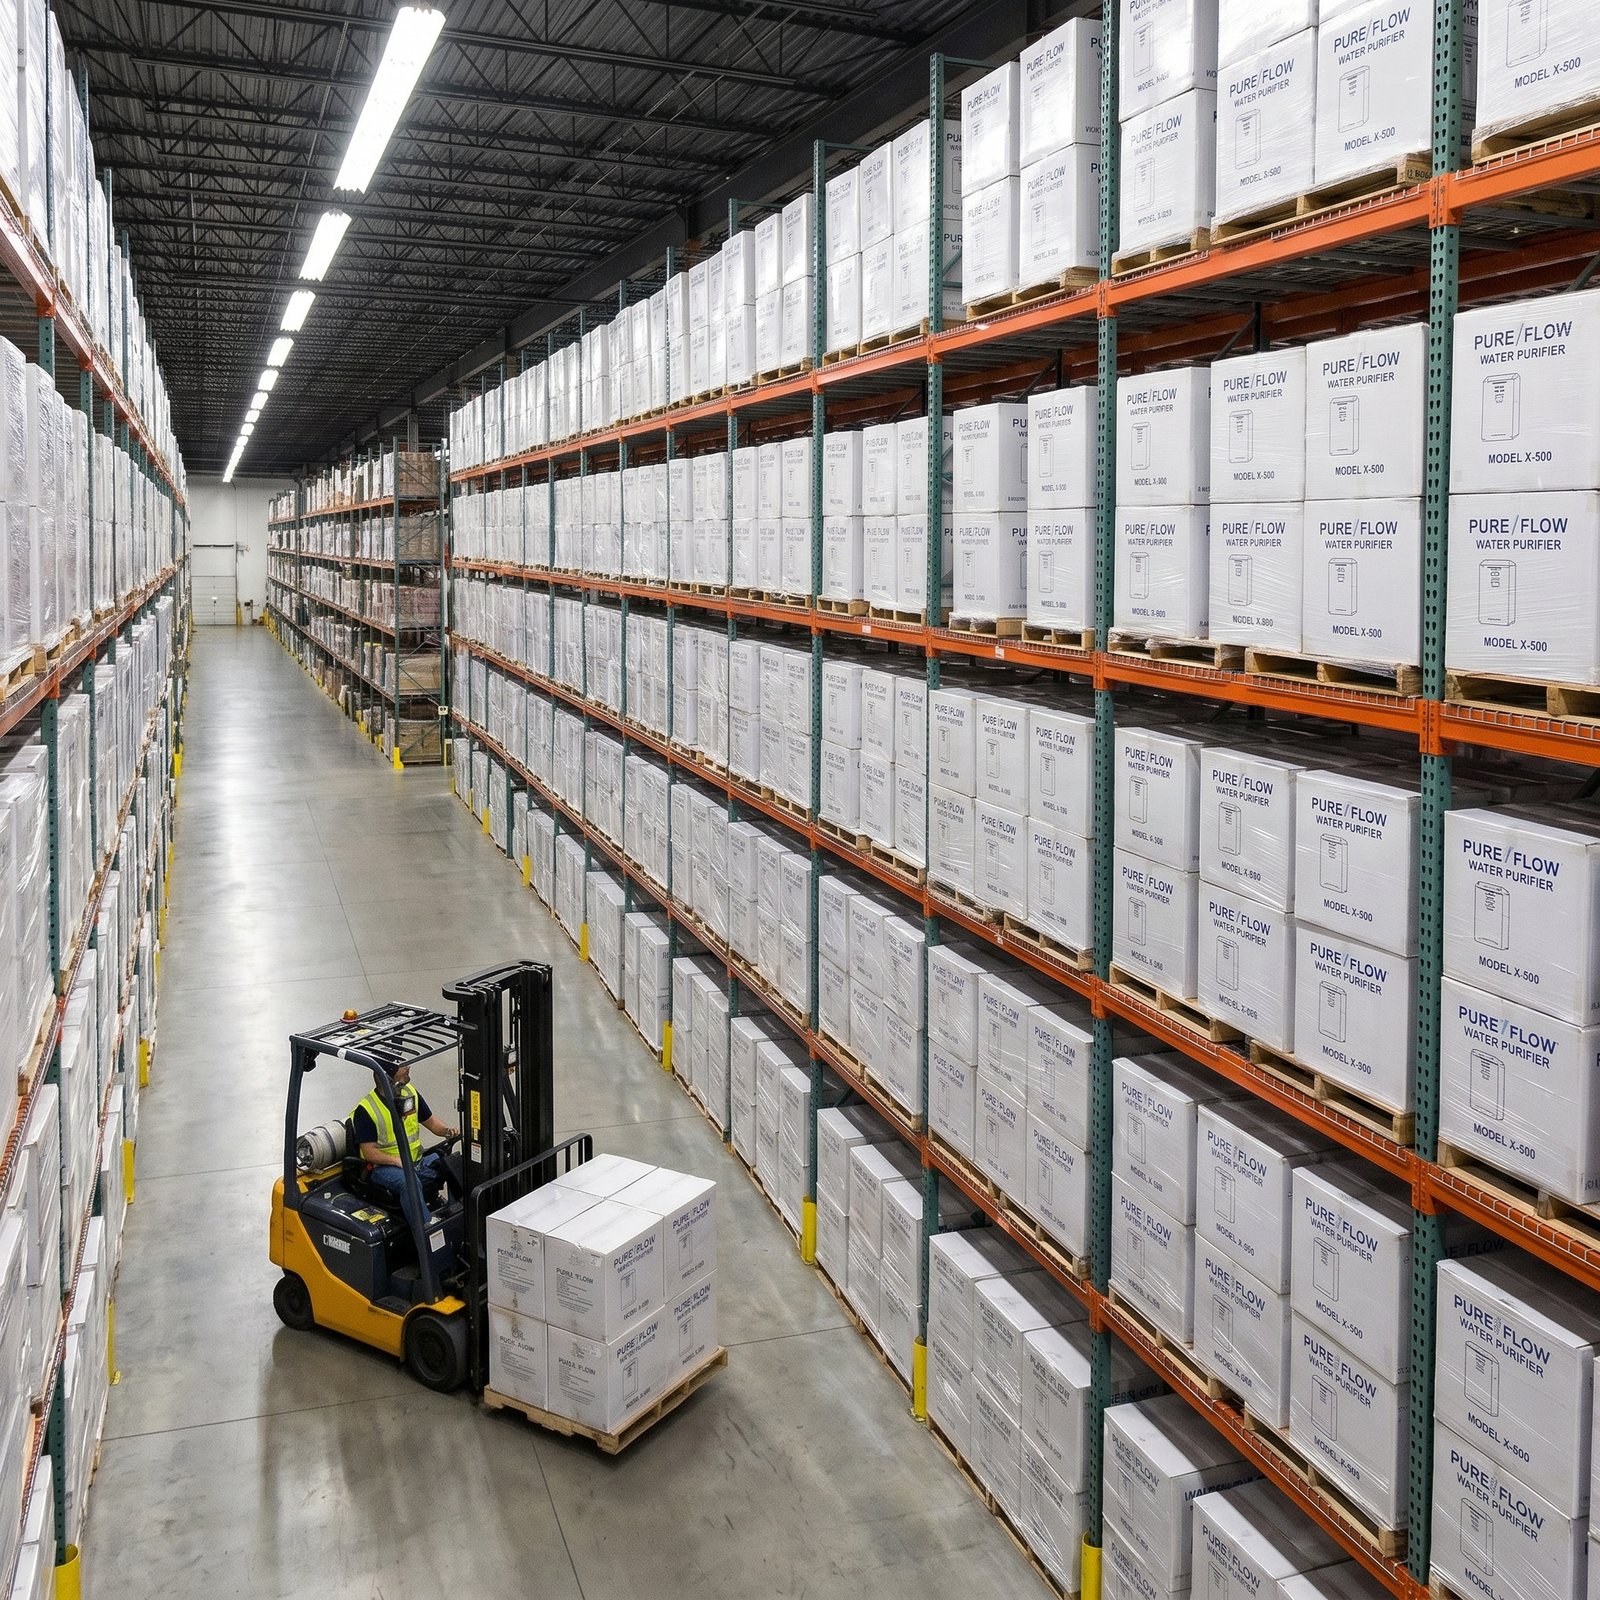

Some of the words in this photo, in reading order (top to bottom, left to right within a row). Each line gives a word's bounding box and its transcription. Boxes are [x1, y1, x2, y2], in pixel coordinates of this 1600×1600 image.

[1334, 7, 1411, 53] PURE/FLOW
[1338, 45, 1366, 65] WATER
[1367, 29, 1406, 53] PURIFIER
[1514, 69, 1550, 89] MODEL
[1552, 57, 1581, 74] X-500
[1234, 90, 1257, 108] WATER
[1344, 136, 1372, 151] MODEL
[1373, 126, 1396, 142] X-500
[1474, 321, 1572, 350] PURE/FLOW
[1323, 350, 1400, 376] PURE/FLOW
[1480, 350, 1515, 365] WATER
[1516, 344, 1566, 361] PURIFIER
[1223, 370, 1287, 391] PURE/FLOW
[1327, 377, 1355, 389] WATER
[1356, 372, 1395, 385] PURIFIER
[1227, 392, 1249, 404] WATER
[1250, 388, 1283, 400] PURIFIER
[1335, 465, 1362, 476] MODEL
[1363, 463, 1385, 474] X-500
[1488, 452, 1523, 464] MODEL
[1524, 451, 1553, 463] X-500
[1233, 471, 1256, 481] MODEL
[1221, 519, 1286, 537] PURE/FLOW
[1319, 518, 1398, 537] PURE/FLOW
[1469, 515, 1569, 537] PURE/FLOW
[1225, 538, 1249, 548] WATER
[1324, 540, 1353, 550] WATER
[1353, 540, 1393, 550] PURIFIER
[1475, 539, 1511, 550] WATER
[1512, 539, 1562, 550] PURIFIER
[1332, 624, 1360, 636] MODEL
[1360, 627, 1382, 639] X-500
[1483, 636, 1518, 649] MODEL
[1519, 638, 1548, 652] X-500
[1215, 785, 1239, 800] WATER
[1239, 791, 1270, 808] PURIFIER
[1311, 796, 1388, 828] PURE/FLOW
[1315, 814, 1344, 830] WATER
[1344, 821, 1383, 841] PURIFIER
[1463, 838, 1560, 877] PURE/FLOW
[1468, 859, 1504, 878] WATER
[1505, 868, 1554, 893] PURIFIER
[1323, 898, 1351, 915] MODEL
[1351, 907, 1374, 922] X-500
[1213, 917, 1237, 935] WATER
[1310, 942, 1388, 984] PURE/FLOW
[1478, 955, 1512, 976] MODEL
[1513, 966, 1540, 985] X-500
[1315, 960, 1343, 980] WATER
[1343, 972, 1383, 997] PURIFIER
[1458, 1004, 1557, 1056] PURE/FLOW
[1322, 1045, 1350, 1065] MODEL
[1463, 1024, 1500, 1050] WATER
[1500, 1040, 1551, 1070] PURIFIER
[1147, 1096, 1173, 1121] FLOW
[1473, 1122, 1508, 1147] MODEL
[1508, 1138, 1537, 1161] X-500
[1237, 1149, 1267, 1178] FLOW
[1146, 1216, 1172, 1241] FLOW
[1309, 1215, 1337, 1241] WATER
[1336, 1234, 1374, 1264] PURIFIER
[1341, 1220, 1379, 1253] FLOW
[1235, 1280, 1267, 1313] FLOW
[1315, 1299, 1341, 1324] MODEL
[1341, 1317, 1364, 1340] X-500
[1459, 1315, 1494, 1346] WATER
[1495, 1337, 1545, 1380] PURIFIER
[1502, 1323, 1551, 1366] FLOW
[1308, 1353, 1334, 1380] WATER
[1335, 1373, 1372, 1410] PURIFIER
[1341, 1361, 1378, 1399] FLOW
[1467, 1411, 1502, 1444] MODEL
[1502, 1436, 1531, 1464] X-500
[1456, 1470, 1491, 1506] WATER
[1491, 1499, 1539, 1543] PURIFIER
[1498, 1484, 1546, 1531] FLOW
[1231, 1554, 1261, 1590] FLOW
[1463, 1566, 1497, 1600] MODEL
